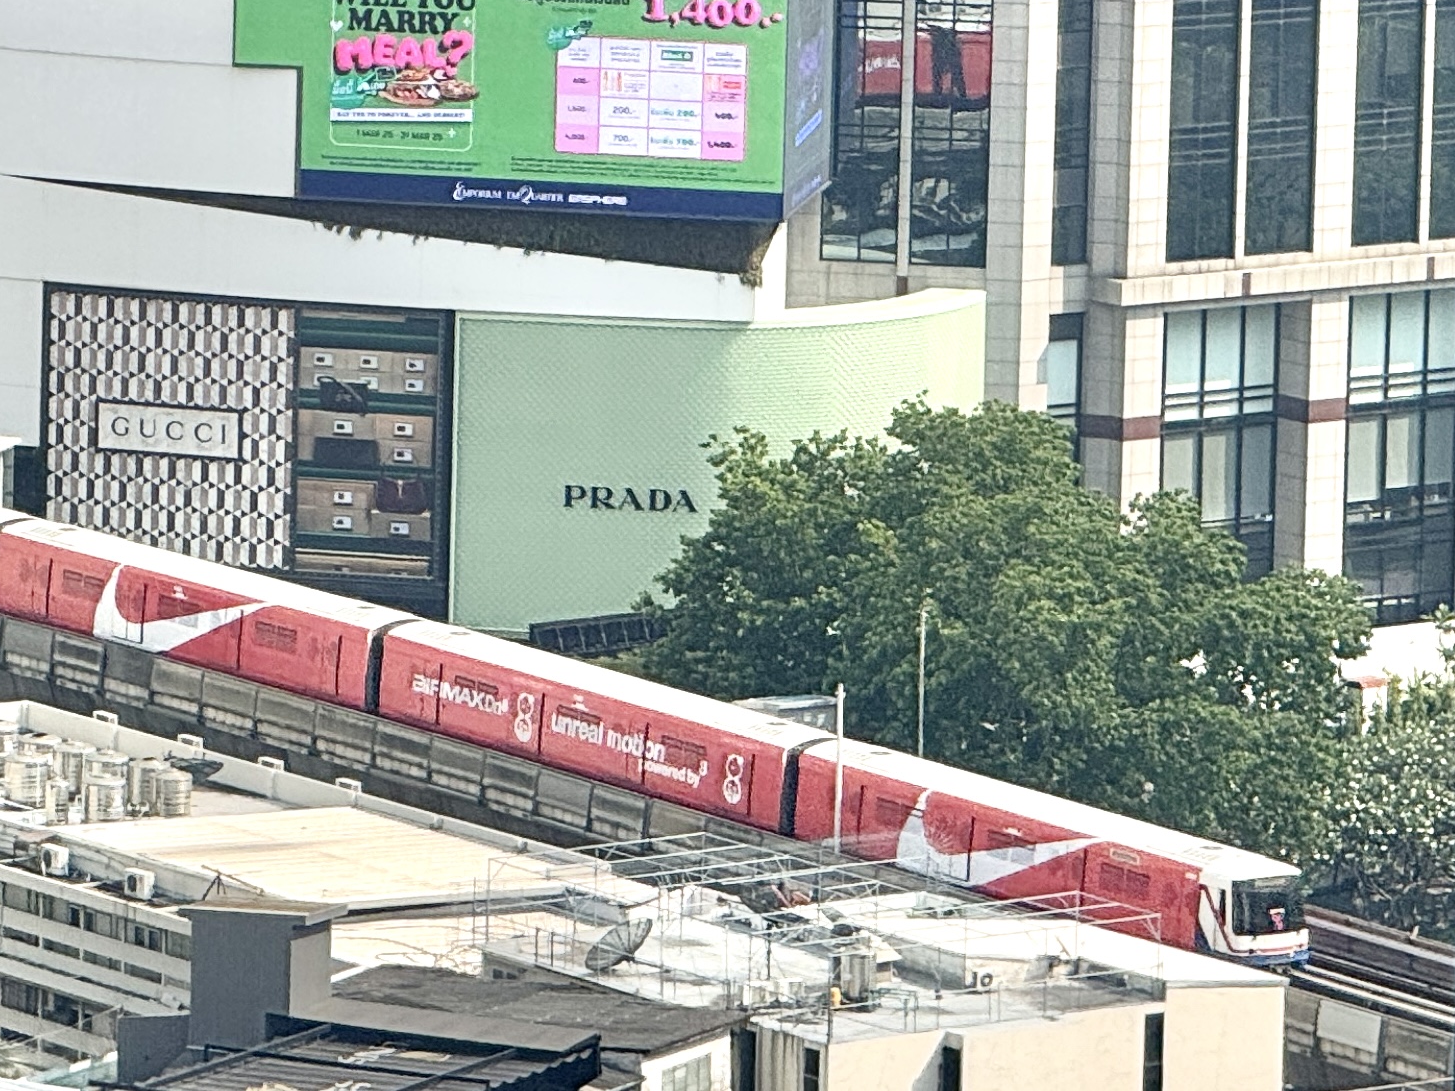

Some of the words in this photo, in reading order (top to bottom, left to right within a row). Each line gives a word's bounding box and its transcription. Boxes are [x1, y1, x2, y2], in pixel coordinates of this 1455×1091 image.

[348, 8, 460, 35] MARRY
[334, 30, 473, 76] MEAL?
[111, 416, 226, 444] GUCCI
[563, 484, 699, 513] PRADA
[551, 712, 604, 745] unreal
[606, 729, 666, 763] motion
